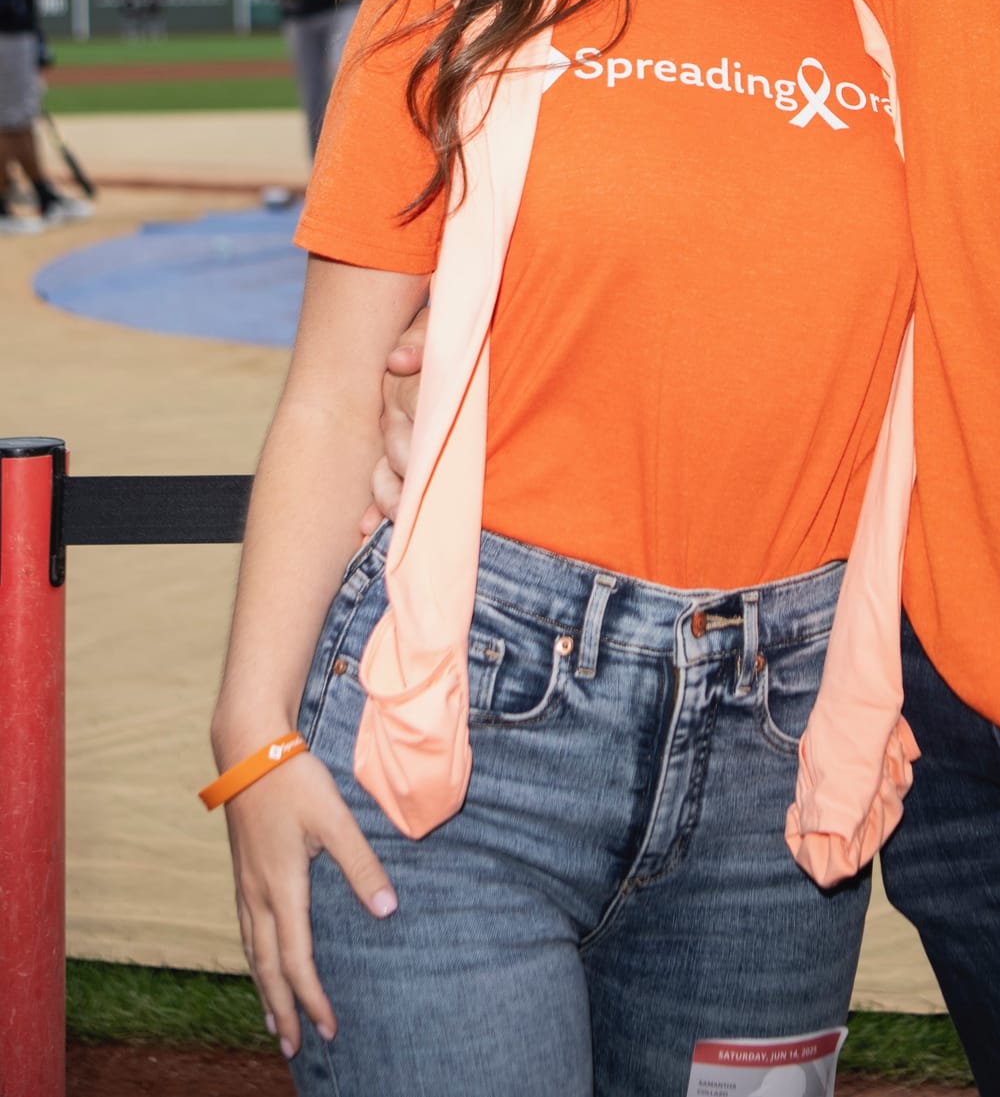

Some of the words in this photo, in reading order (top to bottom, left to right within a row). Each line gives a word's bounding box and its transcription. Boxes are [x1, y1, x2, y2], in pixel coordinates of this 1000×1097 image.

[574, 47, 799, 112] Spreading
[718, 1049, 769, 1063] SATURDAY,
[770, 1049, 787, 1063] JUN
